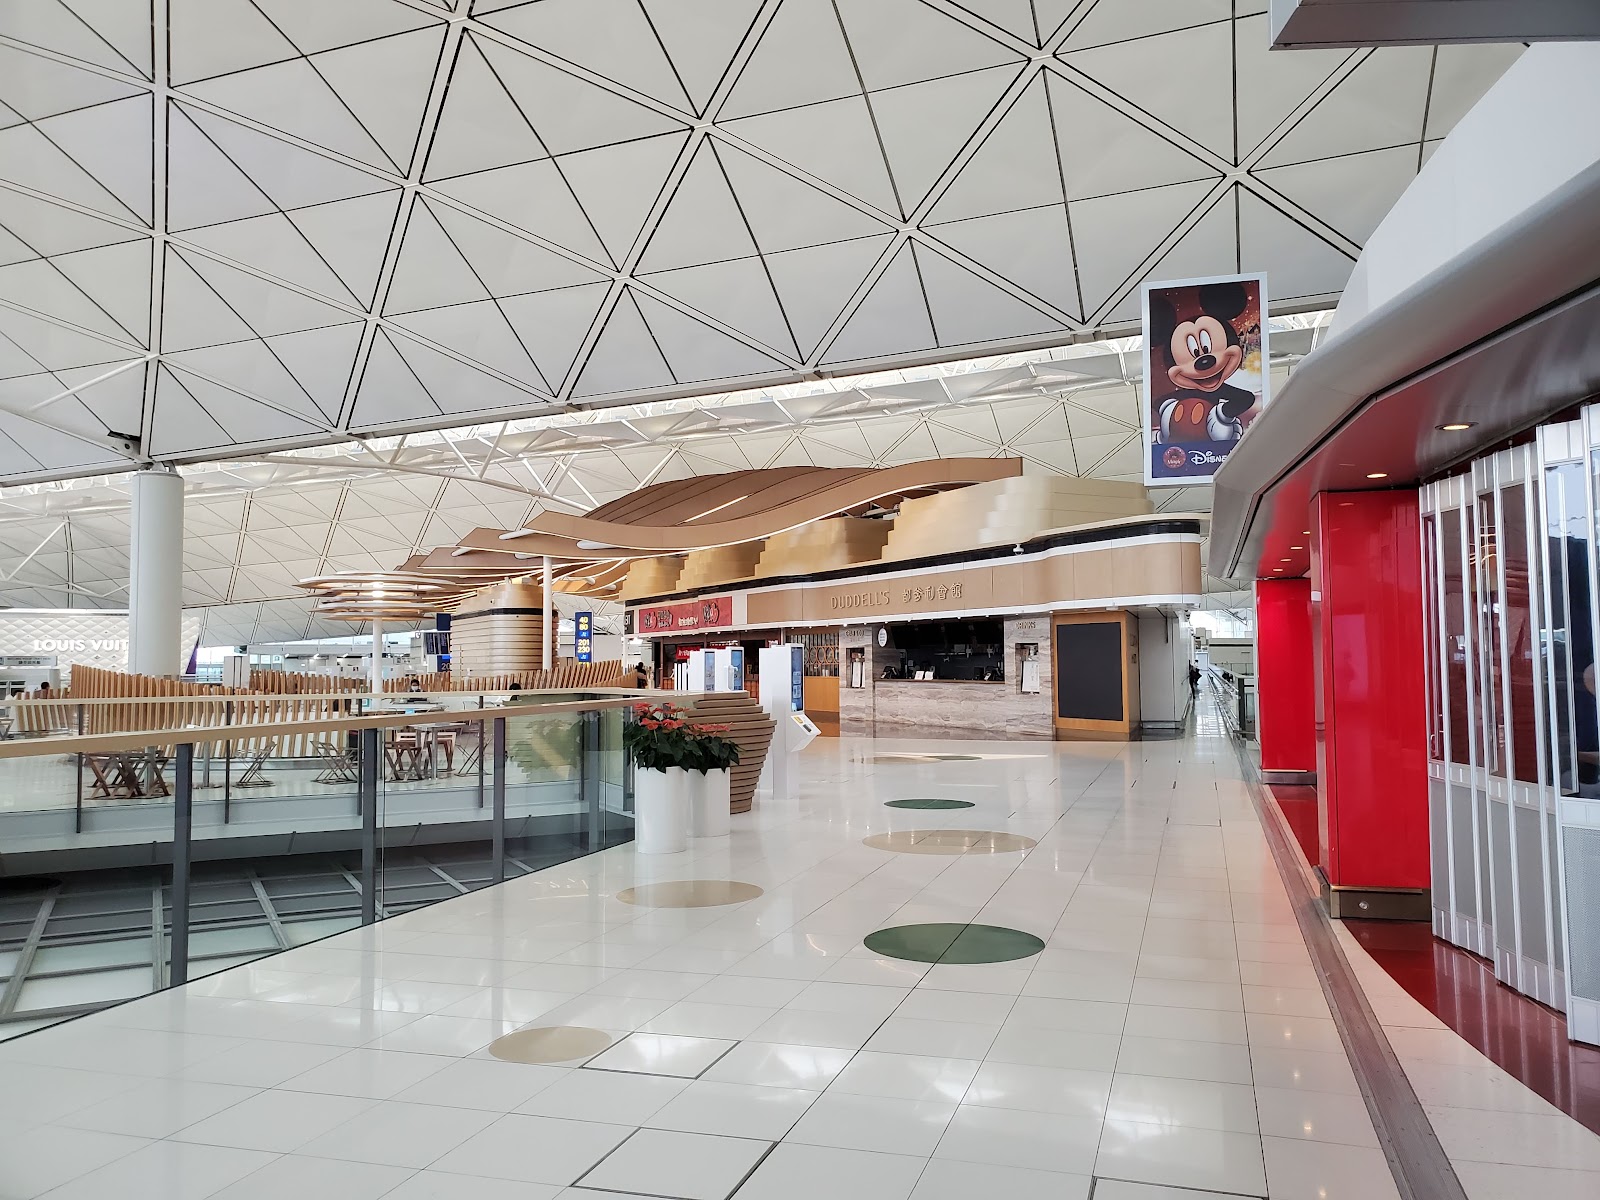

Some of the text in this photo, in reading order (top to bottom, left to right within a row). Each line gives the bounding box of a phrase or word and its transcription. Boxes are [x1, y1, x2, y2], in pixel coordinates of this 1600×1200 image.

[831, 591, 890, 609] DUDDELL'S
[34, 639, 129, 651] LOUIS VUIT
[441, 662, 450, 670] 20
